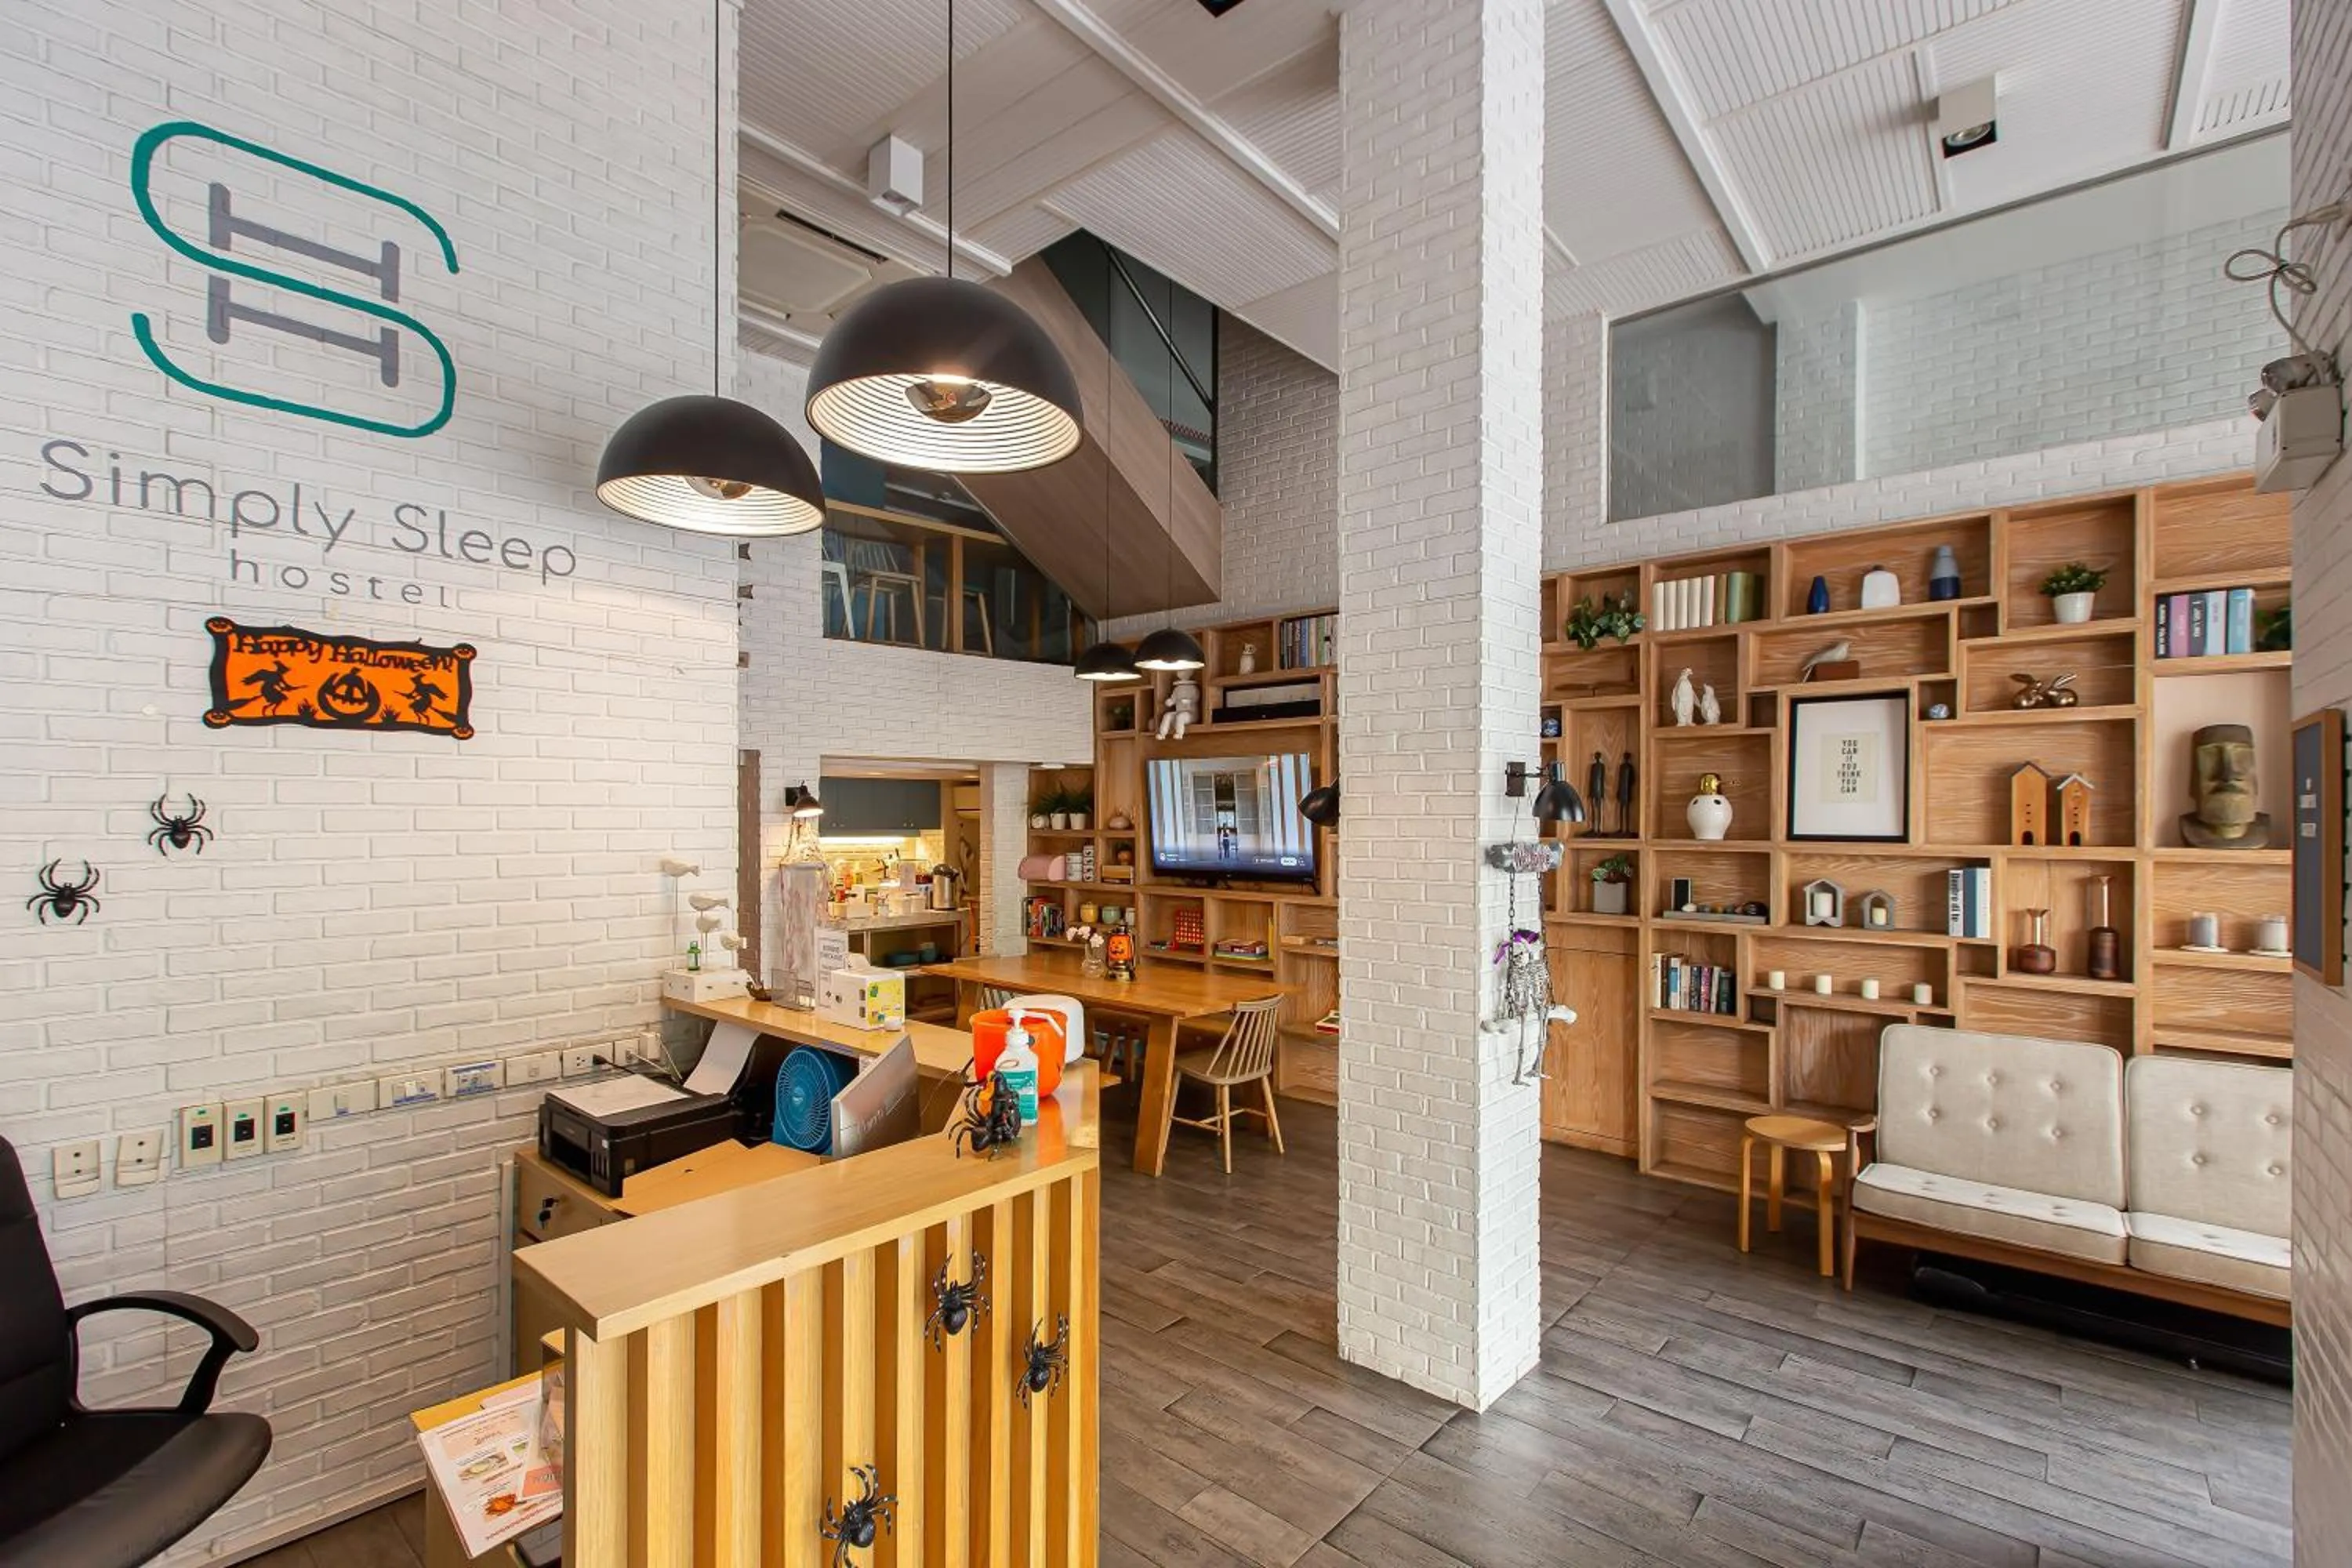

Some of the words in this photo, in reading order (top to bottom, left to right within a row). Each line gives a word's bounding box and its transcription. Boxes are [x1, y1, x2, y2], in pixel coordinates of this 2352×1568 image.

[40, 439, 355, 554] Simply
[392, 503, 577, 586] Sleep
[230, 548, 449, 609] hostel
[234, 633, 322, 664] Happy
